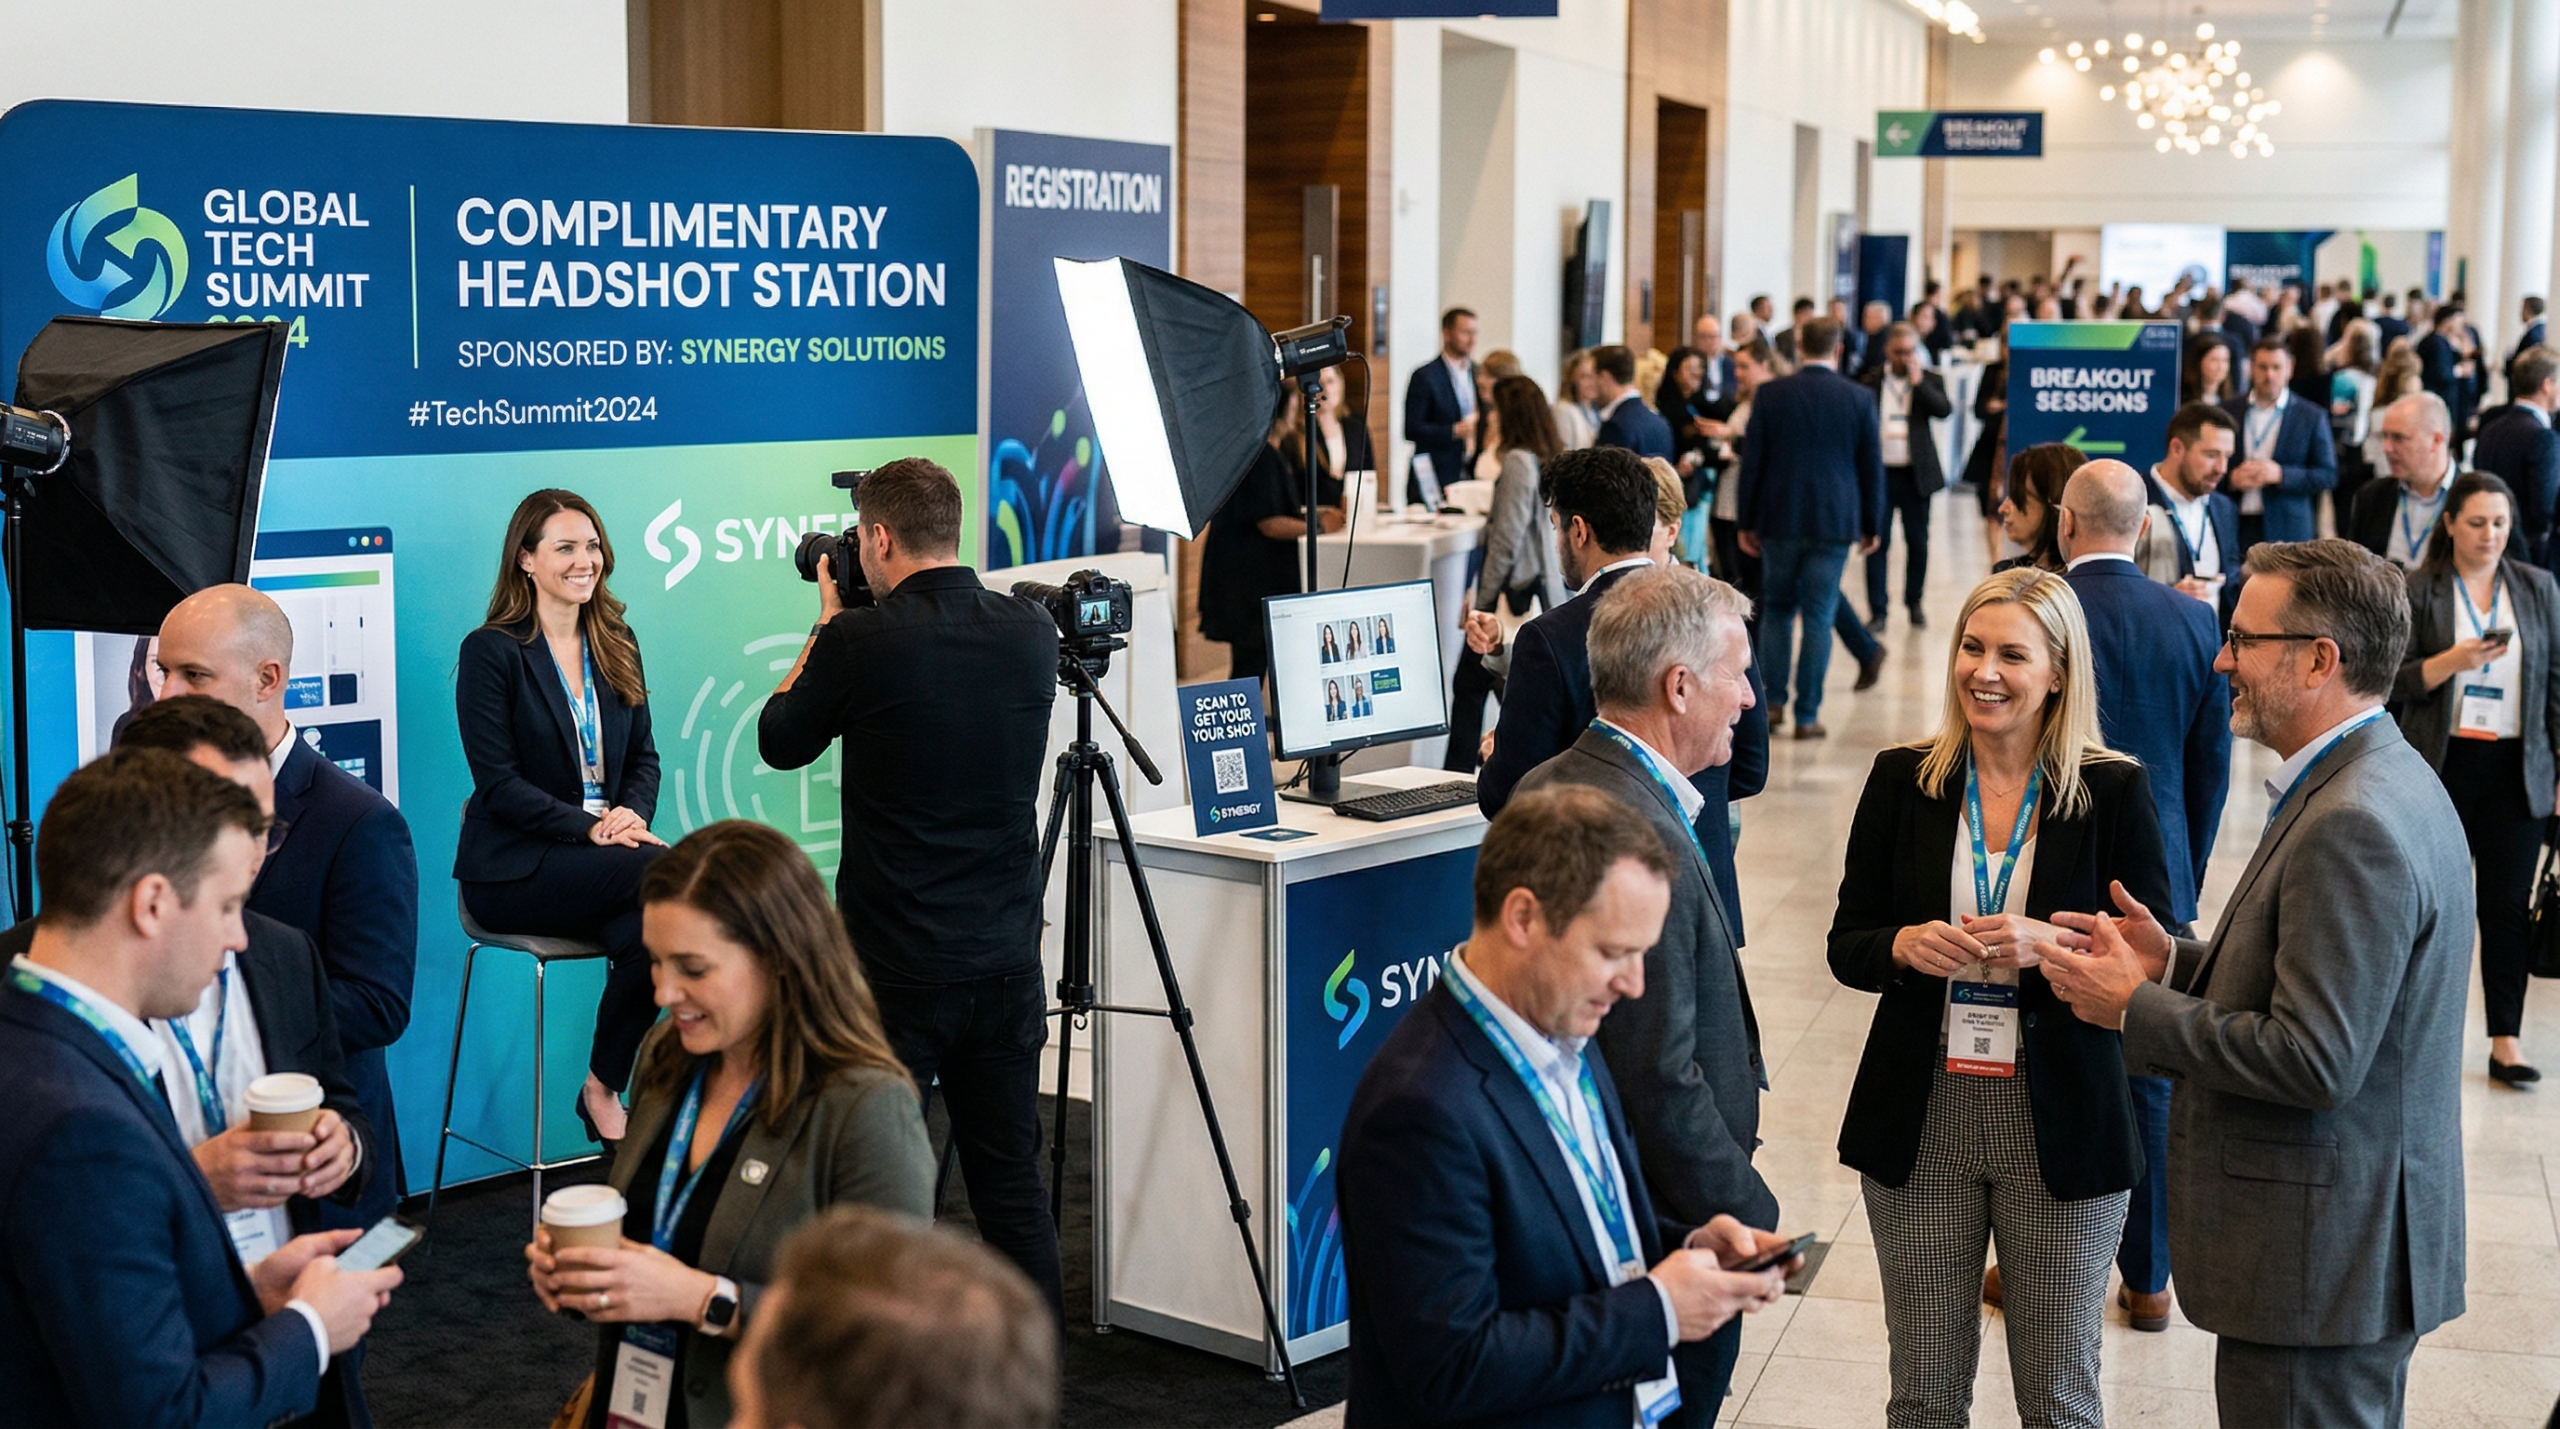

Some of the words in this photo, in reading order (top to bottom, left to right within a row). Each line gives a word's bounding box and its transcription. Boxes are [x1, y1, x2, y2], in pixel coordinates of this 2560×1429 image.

[1005, 164, 1162, 214] REGISTRATION
[204, 188, 370, 227] GLOBAL
[457, 197, 888, 250] COMPLIMENTARY
[204, 230, 314, 267] TECH
[206, 272, 370, 308] SUMMIT
[458, 260, 740, 308] HEADSHOT
[753, 262, 945, 308] STATION
[458, 340, 628, 368] SPONSORED
[636, 340, 673, 365] BY:
[681, 338, 801, 365] SYNERGY
[808, 336, 946, 363] SOLUTIONS
[2030, 367, 2155, 390] BREAKOUT
[408, 396, 658, 427] #TechSummit2024
[2035, 390, 2149, 413] SESSIONS
[715, 513, 859, 563] SYN
[1194, 712, 1217, 728] GET
[1219, 708, 1252, 725] YOUR
[1195, 694, 1229, 712] SCAN
[1230, 693, 1247, 707] TO
[1191, 727, 1225, 744] YOUR
[1226, 722, 1257, 739] SHOT
